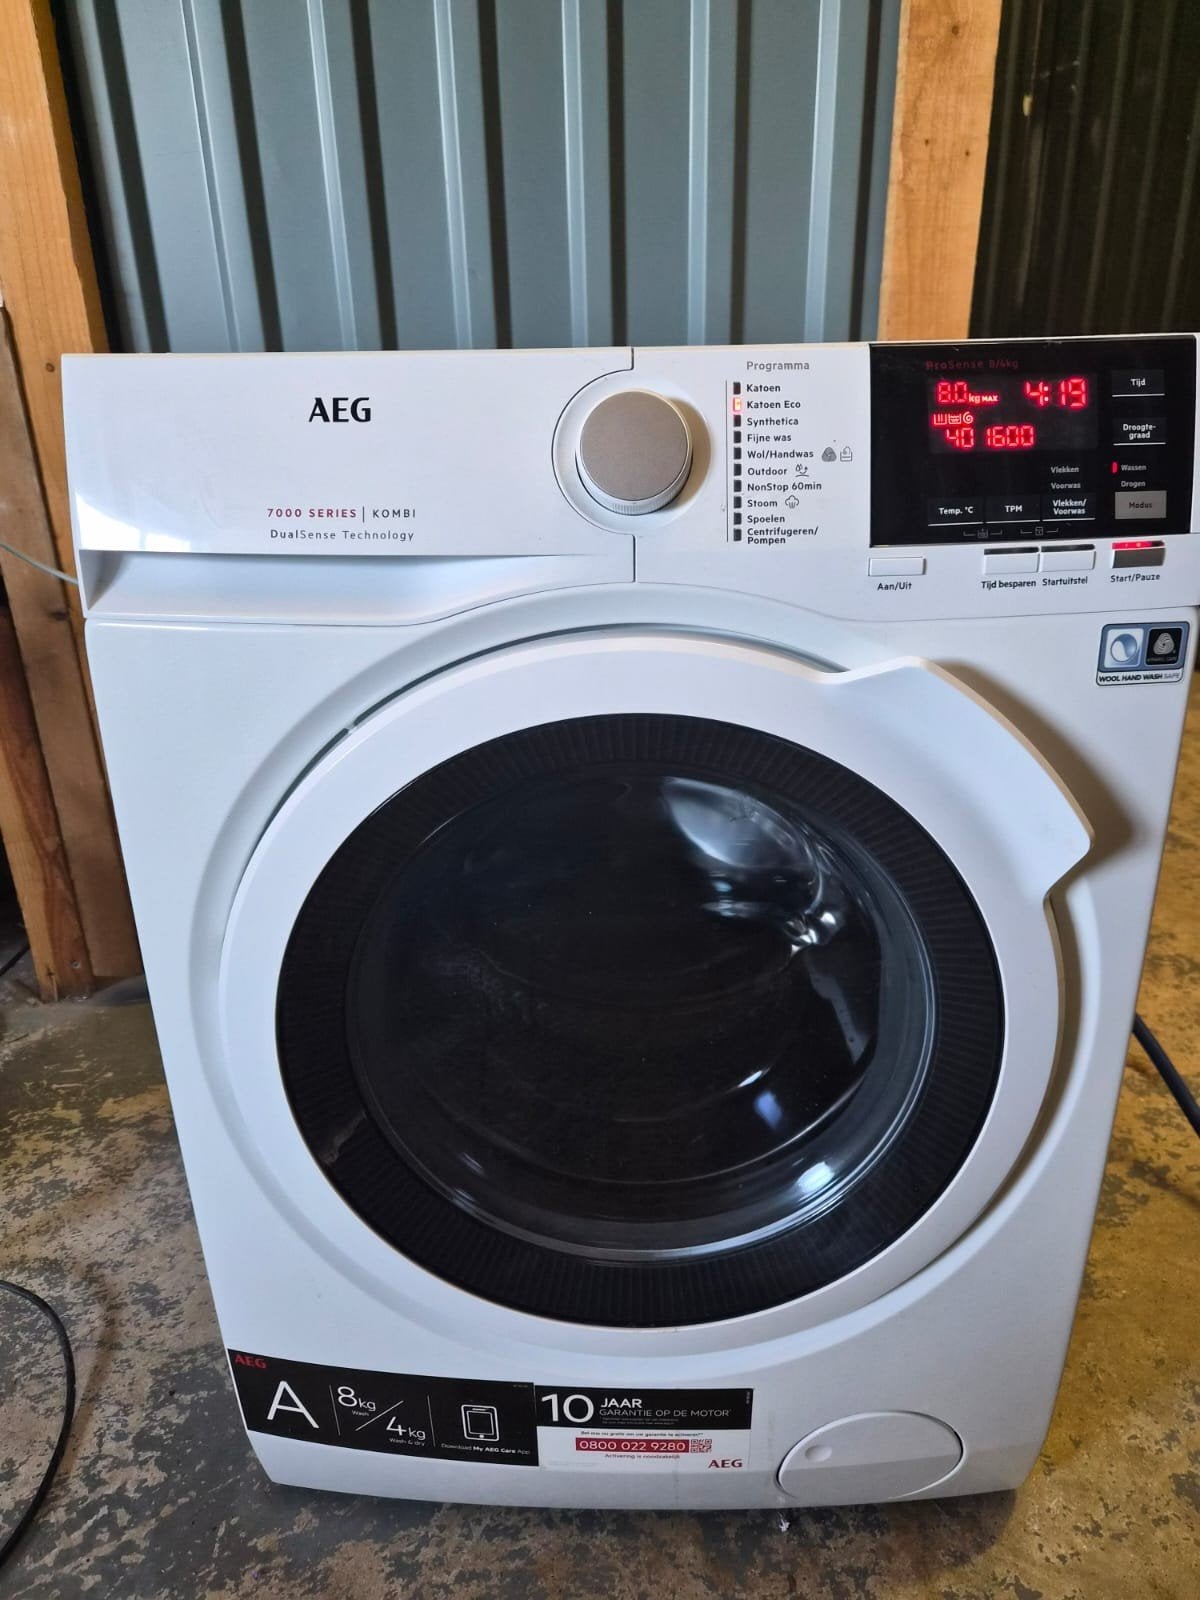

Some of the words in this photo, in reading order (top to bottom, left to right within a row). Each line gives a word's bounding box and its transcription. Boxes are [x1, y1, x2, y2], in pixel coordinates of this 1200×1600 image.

[746, 360, 810, 373] Programma
[1130, 377, 1146, 388] Tijd
[746, 383, 781, 393] Katoen
[1024, 377, 1088, 408] 4:19
[981, 394, 999, 403] MAX
[308, 397, 371, 422] AEG
[746, 400, 781, 410] Katoen
[784, 400, 801, 409] Eco
[746, 416, 799, 427] Synthetica
[747, 433, 770, 443] Fijne
[773, 434, 792, 442] was
[945, 426, 975, 449] 40
[986, 425, 1034, 448] 1600
[1128, 431, 1151, 441] graad
[747, 449, 814, 460] Wol/Handwas
[747, 466, 788, 476] Outdoor
[1050, 466, 1080, 474] Vlekken
[747, 482, 789, 493] NonStop
[791, 481, 822, 491] 60min
[1050, 482, 1081, 490] Voorwas
[1120, 481, 1146, 489] Drogen
[747, 499, 778, 508] Stoom
[1052, 498, 1087, 507] Vlekken/
[1128, 501, 1153, 509] Modus
[267, 508, 302, 518] 7000
[309, 508, 357, 518] SERIES
[373, 508, 416, 518] KOMBI
[938, 506, 964, 517] Temp.
[1004, 504, 1023, 513] TPM
[1053, 507, 1086, 516] Voorwas
[747, 514, 786, 525] Spoelen
[270, 529, 336, 539] DualSense
[342, 530, 414, 541] Technology
[747, 526, 819, 537] Centrifugeren/
[747, 536, 786, 546] Pompen
[1041, 576, 1088, 587] Startuitstel
[1110, 572, 1161, 583] Start/Pauze
[876, 581, 912, 591] Aan/Uit
[981, 580, 997, 590] Tijd
[998, 578, 1037, 590] besparen
[234, 1354, 267, 1370] AEG
[266, 1380, 320, 1429] A
[600, 1398, 643, 1408] JAAR
[541, 1393, 595, 1424] 10
[599, 1408, 652, 1417] GARANTIE
[655, 1409, 671, 1417] OP
[673, 1409, 688, 1417] DE
[579, 1440, 617, 1450] 0800
[621, 1441, 646, 1451] 022
[651, 1441, 686, 1451] 9280
[708, 1459, 743, 1469] AEG
